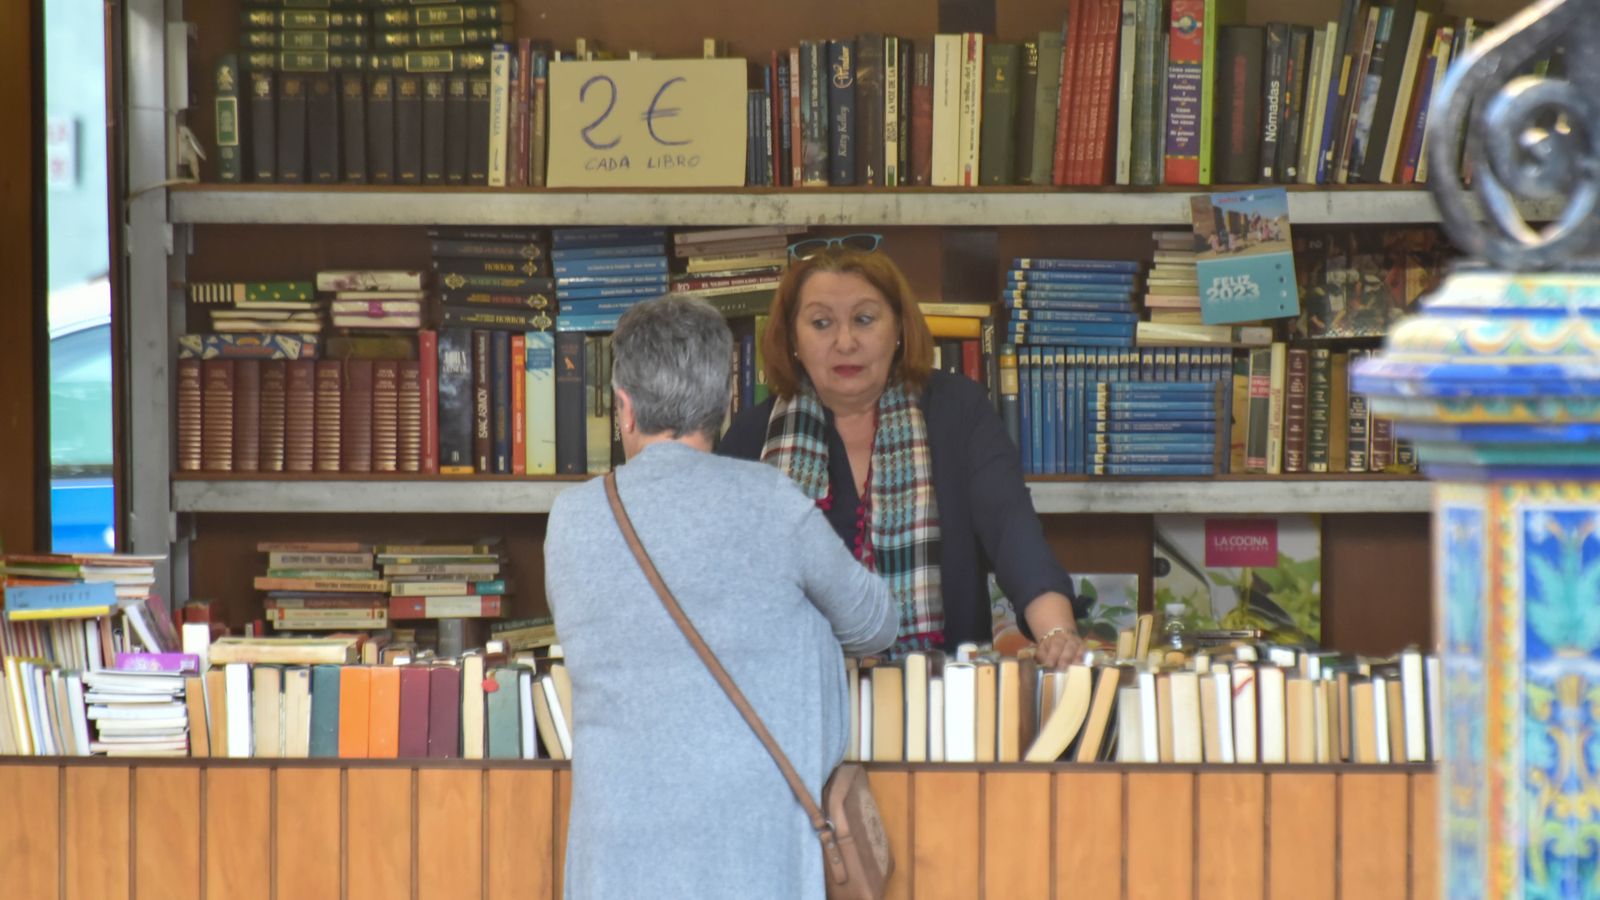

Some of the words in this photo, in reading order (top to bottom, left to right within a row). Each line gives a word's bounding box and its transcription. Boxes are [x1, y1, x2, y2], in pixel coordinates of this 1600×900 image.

[579, 74, 621, 150] 2
[640, 76, 694, 146] €
[1264, 80, 1280, 142] Nómadas
[585, 155, 630, 172] CADA
[647, 154, 701, 169] LIBRO
[1212, 274, 1251, 288] FELIZ
[1206, 282, 1260, 301] 2023
[477, 387, 488, 416] ASIMOV
[1214, 536, 1228, 547] LA
[1230, 535, 1269, 547] COCINA
